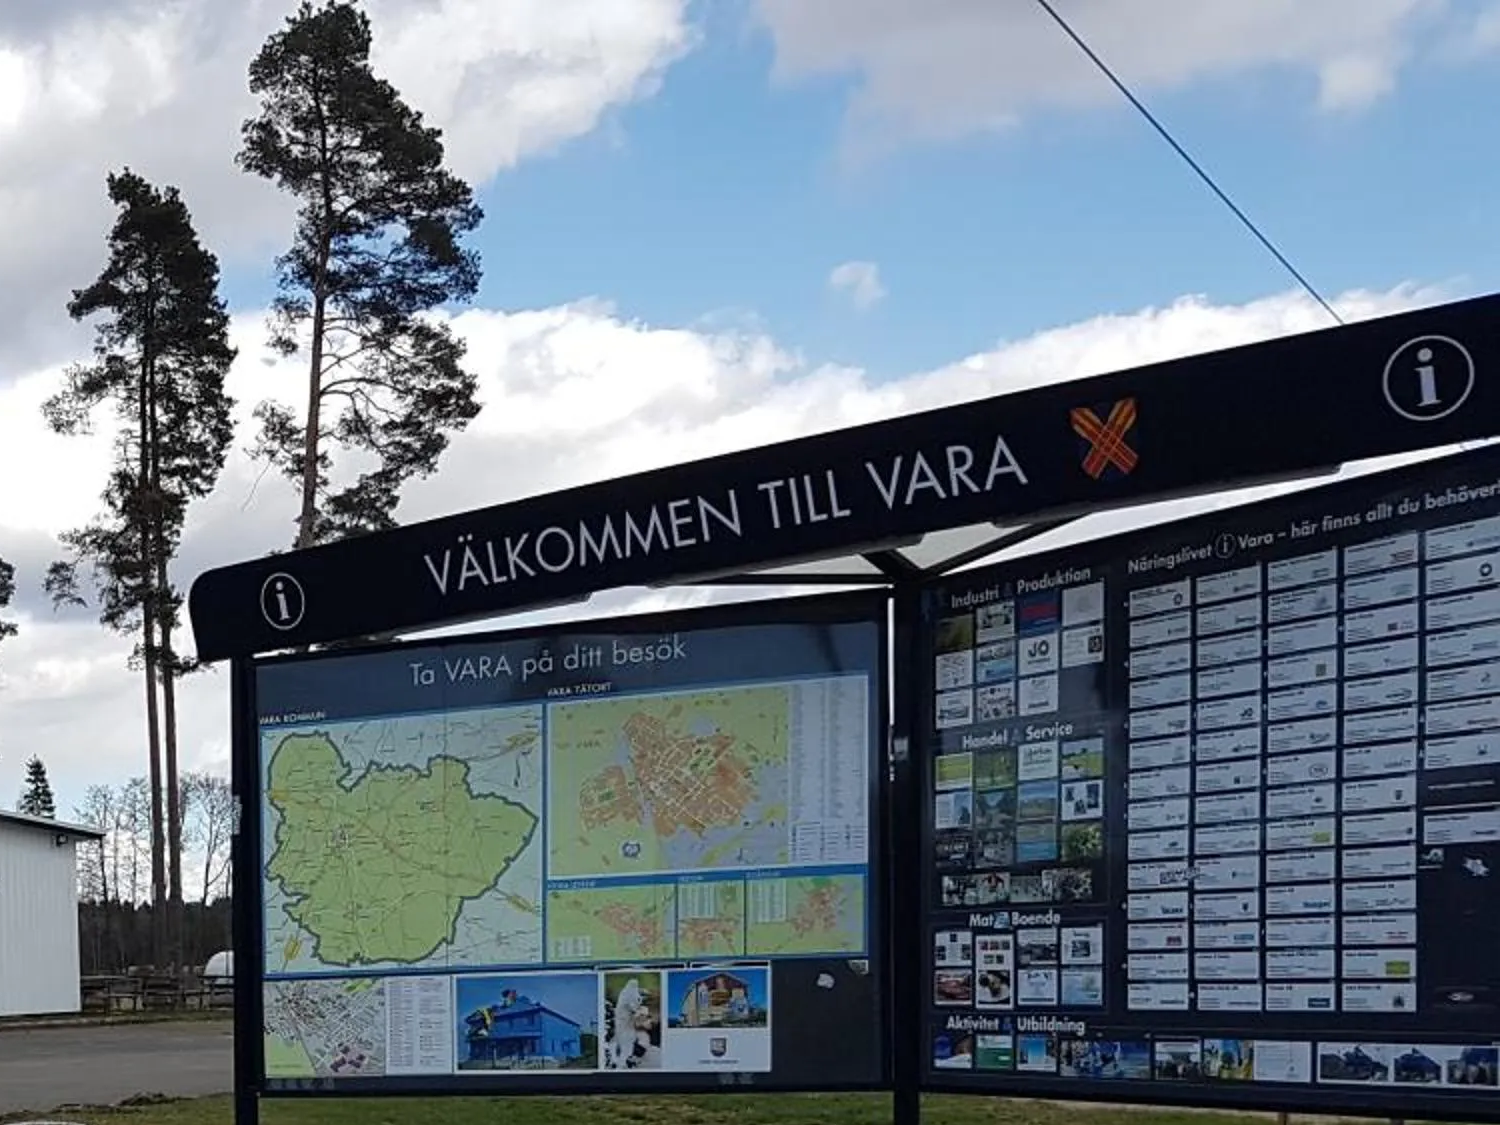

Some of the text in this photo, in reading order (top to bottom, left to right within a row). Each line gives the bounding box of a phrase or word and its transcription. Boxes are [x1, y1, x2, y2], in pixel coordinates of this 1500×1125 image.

[423, 435, 1028, 596] VÄLKOMMEN TILL VARA
[1127, 544, 1212, 574] Näringslivet
[1237, 532, 1274, 549] Vara
[1291, 521, 1319, 539] här
[1322, 512, 1361, 532] finns
[1365, 503, 1393, 523] allt
[1398, 498, 1420, 515] du
[1017, 567, 1092, 595] Produktion
[951, 584, 1000, 609] Industri
[1027, 639, 1050, 658] JO
[409, 634, 687, 686] Ta VARA på ditt besök
[961, 730, 1008, 749] Handel
[1025, 721, 1074, 741] Service
[969, 913, 994, 928] Mat
[1011, 908, 1062, 926] Boende
[946, 1015, 1000, 1031] Aktivitet
[1016, 1015, 1086, 1037] Utbildning
